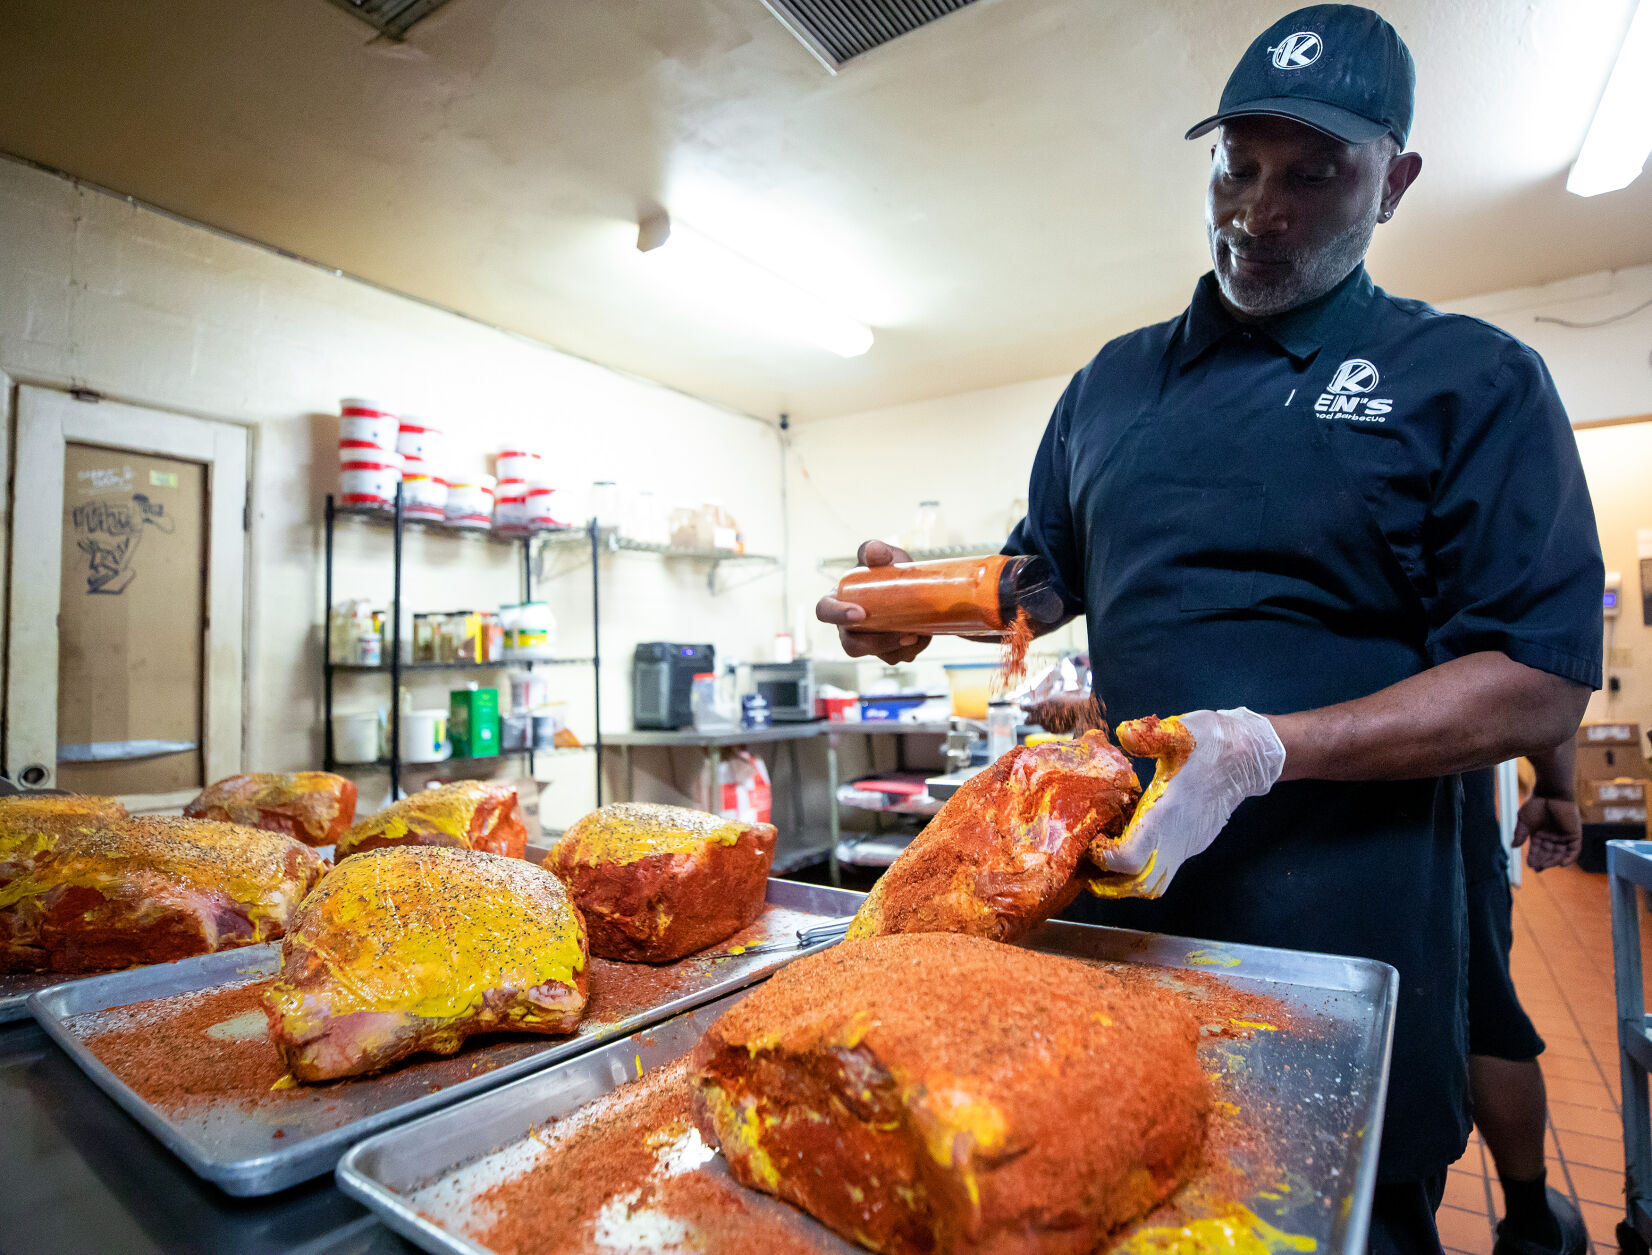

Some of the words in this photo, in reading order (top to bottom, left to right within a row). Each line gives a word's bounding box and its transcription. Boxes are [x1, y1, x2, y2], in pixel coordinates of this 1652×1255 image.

[1277, 34, 1320, 67] K
[1330, 362, 1376, 394] K
[1334, 412, 1386, 423] Barbecue
